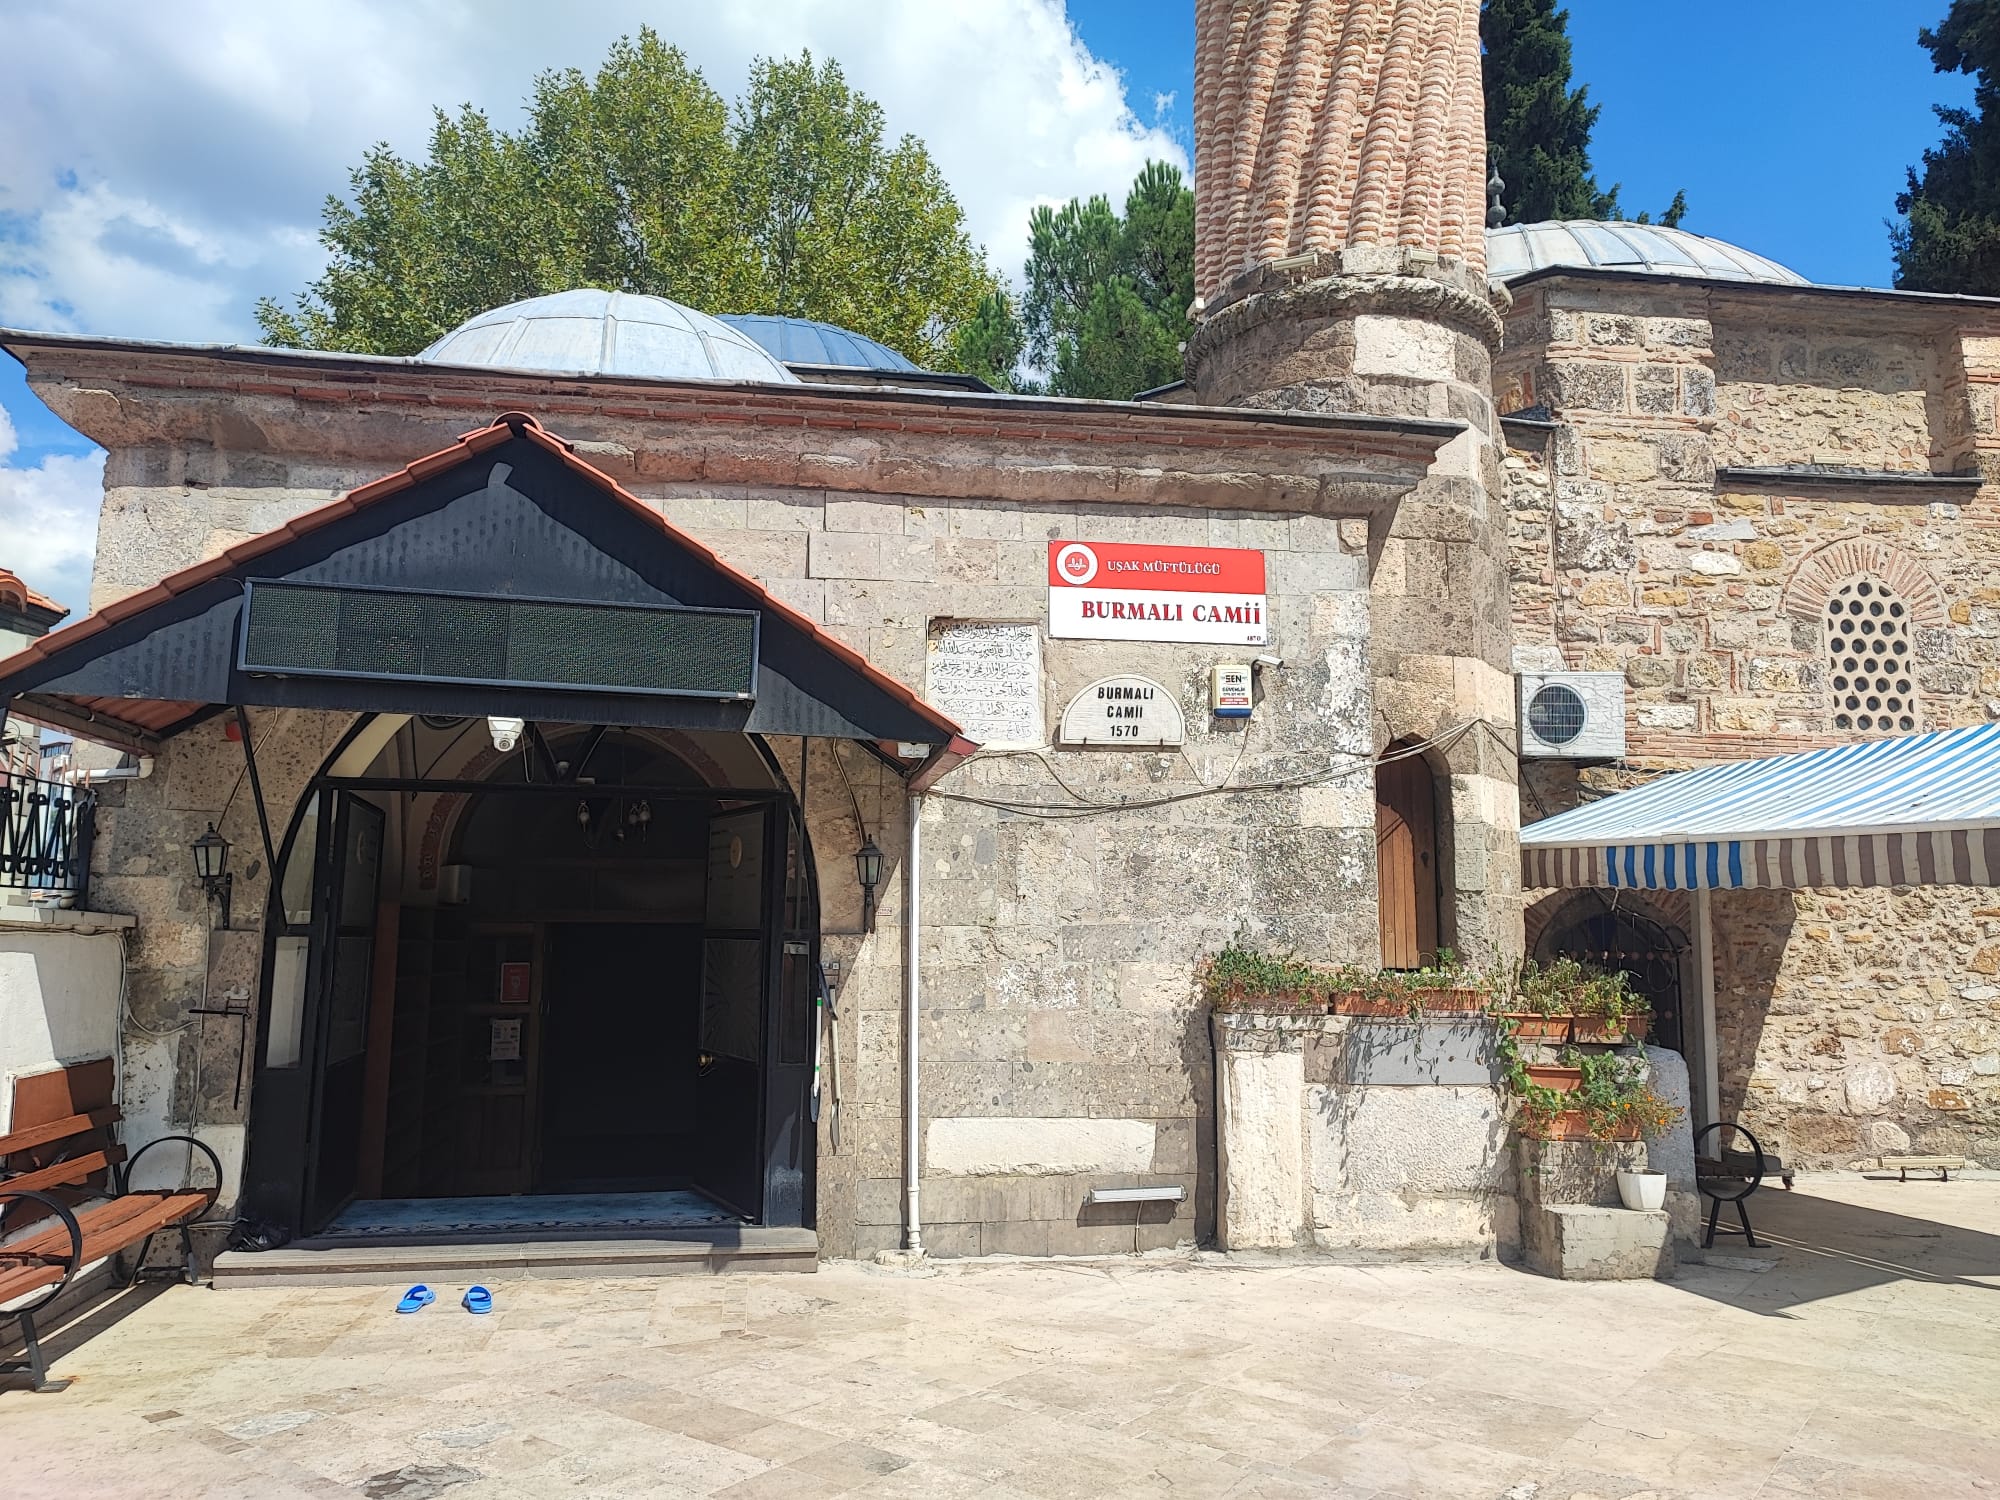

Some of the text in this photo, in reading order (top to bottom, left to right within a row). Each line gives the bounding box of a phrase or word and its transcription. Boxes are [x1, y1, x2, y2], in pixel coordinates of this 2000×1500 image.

[1107, 560, 1221, 575] UŞAK MÜFTÜLÜĞÜ
[1081, 600, 1261, 624] BURMALI CAMİİ
[1097, 686, 1154, 700] BURMALI
[1110, 725, 1139, 737] 1570
